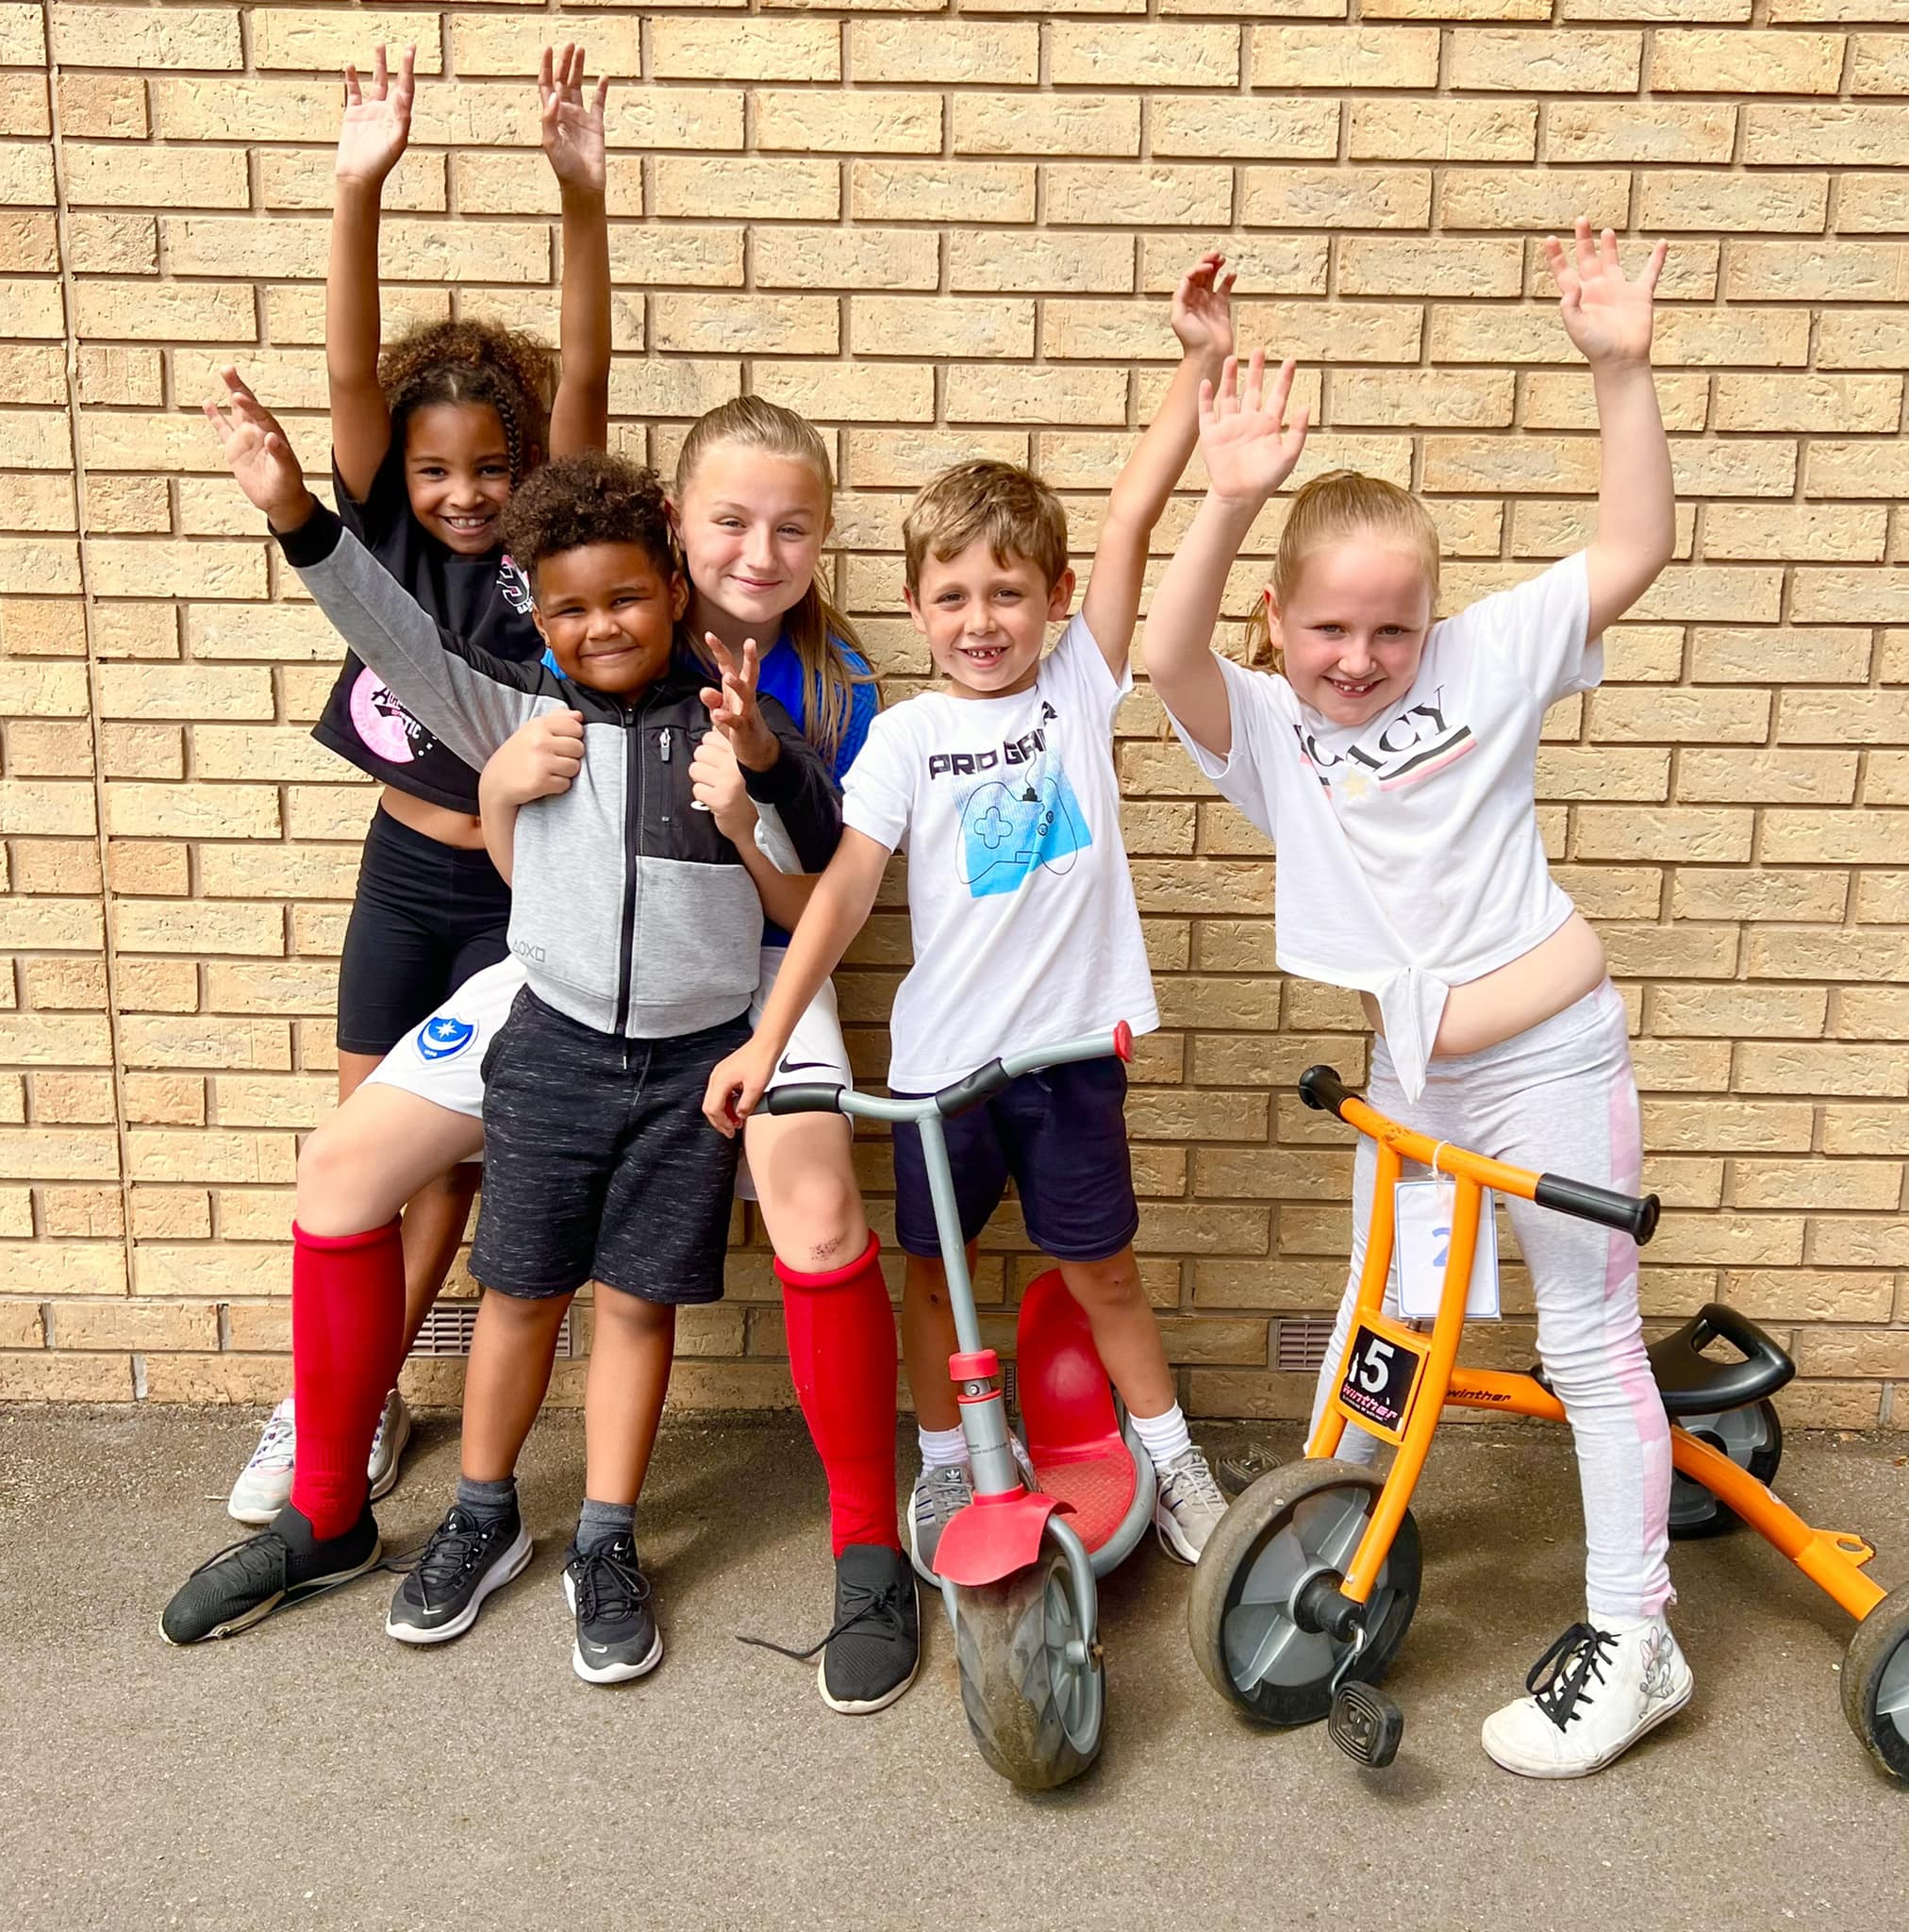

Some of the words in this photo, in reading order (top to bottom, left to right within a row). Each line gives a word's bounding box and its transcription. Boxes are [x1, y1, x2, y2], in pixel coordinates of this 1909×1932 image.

[929, 750, 999, 780] PRO
[1342, 1383, 1398, 1419] winther
[1447, 1388, 1512, 1402] winther
